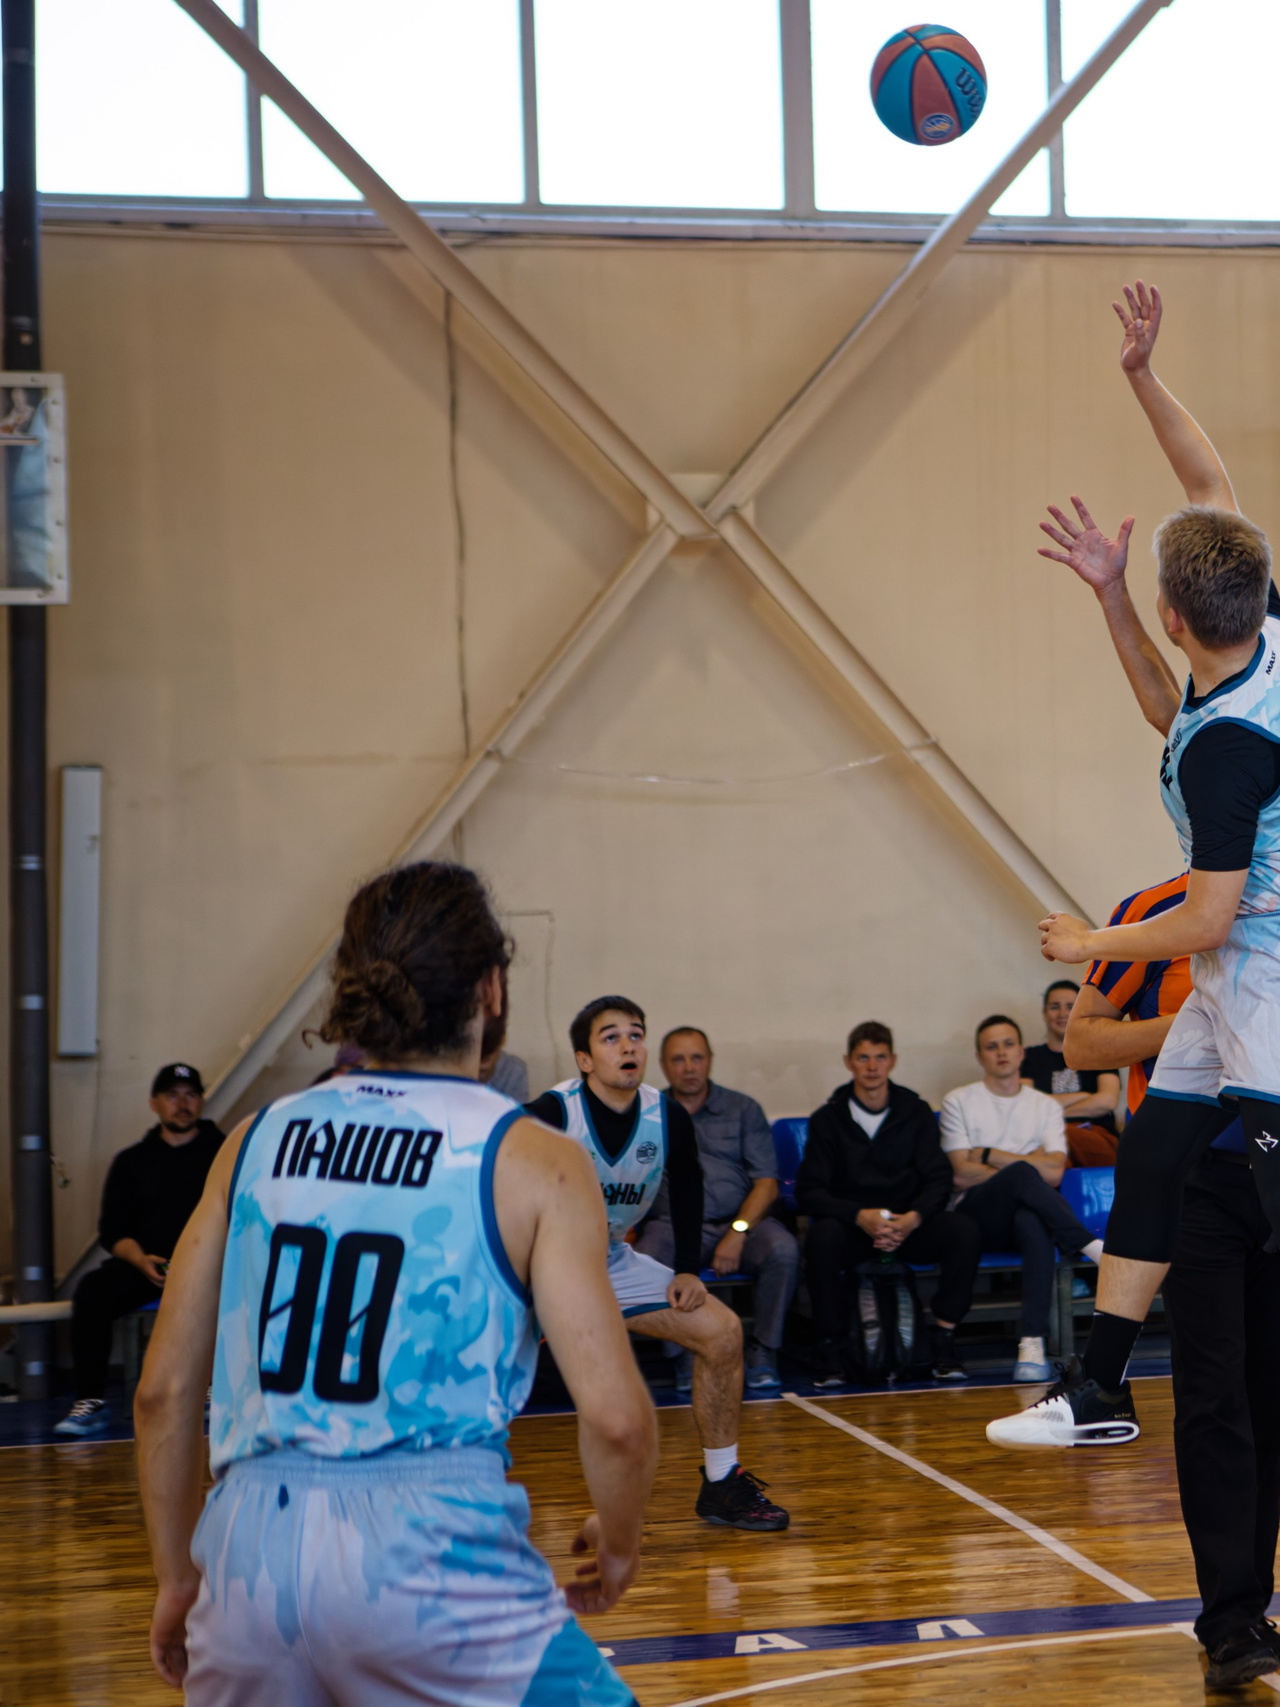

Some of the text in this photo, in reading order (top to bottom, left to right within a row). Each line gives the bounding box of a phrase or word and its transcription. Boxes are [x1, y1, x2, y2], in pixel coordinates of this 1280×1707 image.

[272, 1118, 443, 1188] ПАШОВ
[601, 1182, 646, 1206] АНЫ
[258, 1223, 405, 1405] 00
